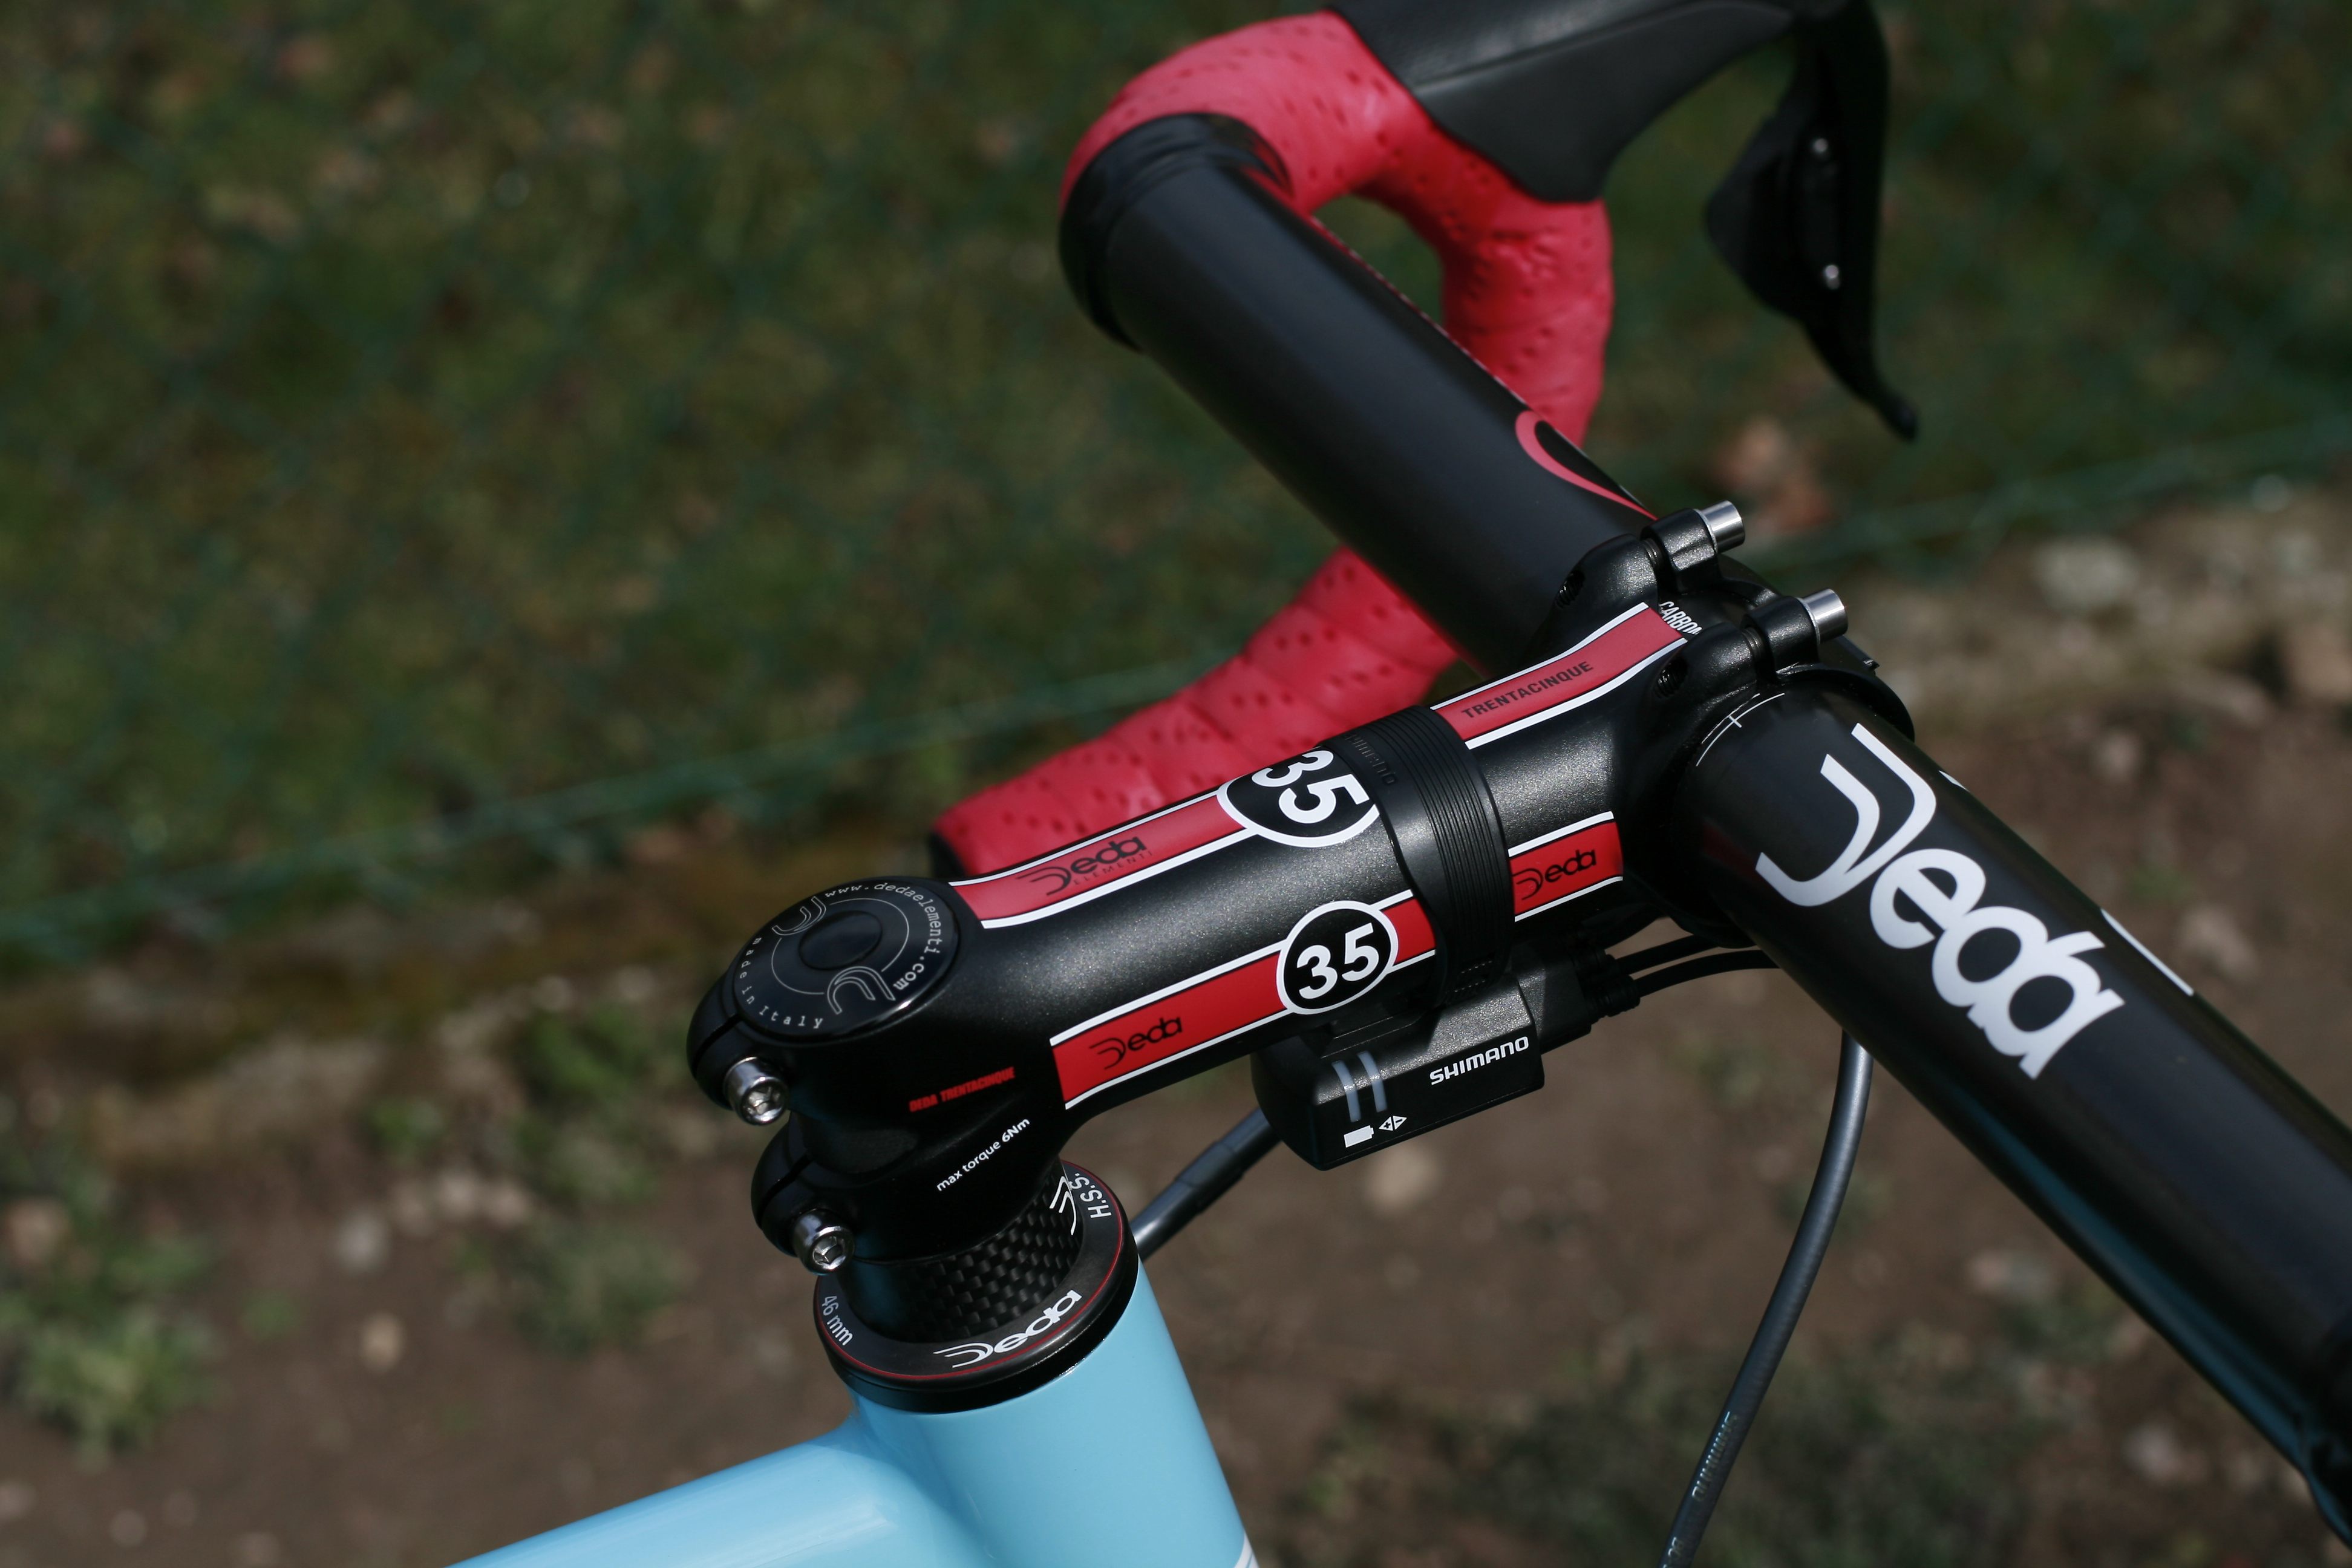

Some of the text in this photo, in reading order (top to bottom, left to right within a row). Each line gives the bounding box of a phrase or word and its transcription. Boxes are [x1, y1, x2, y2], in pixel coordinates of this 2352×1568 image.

[1460, 661, 1594, 719] TRENTACINQUE
[1251, 750, 1370, 825] 35
[1015, 837, 1147, 896] Deda
[1074, 851, 1153, 886] ELEMENTI
[1512, 849, 1597, 901] Deda
[1755, 722, 2125, 1080] Deda
[825, 881, 941, 990] www.dedaelementi.com
[1296, 922, 1380, 1000] 35
[739, 937, 823, 1028] made in Italy
[1089, 1016, 1183, 1070] Deda
[1429, 1036, 1529, 1085] SHIMANO
[909, 1066, 1016, 1112] DEDA TRENTACINQUE
[936, 1119, 1030, 1191] max torque 6Nm
[1068, 1172, 1112, 1219] H.S.S.
[821, 1295, 854, 1346] 46 mm
[933, 1290, 1083, 1368] Deda
